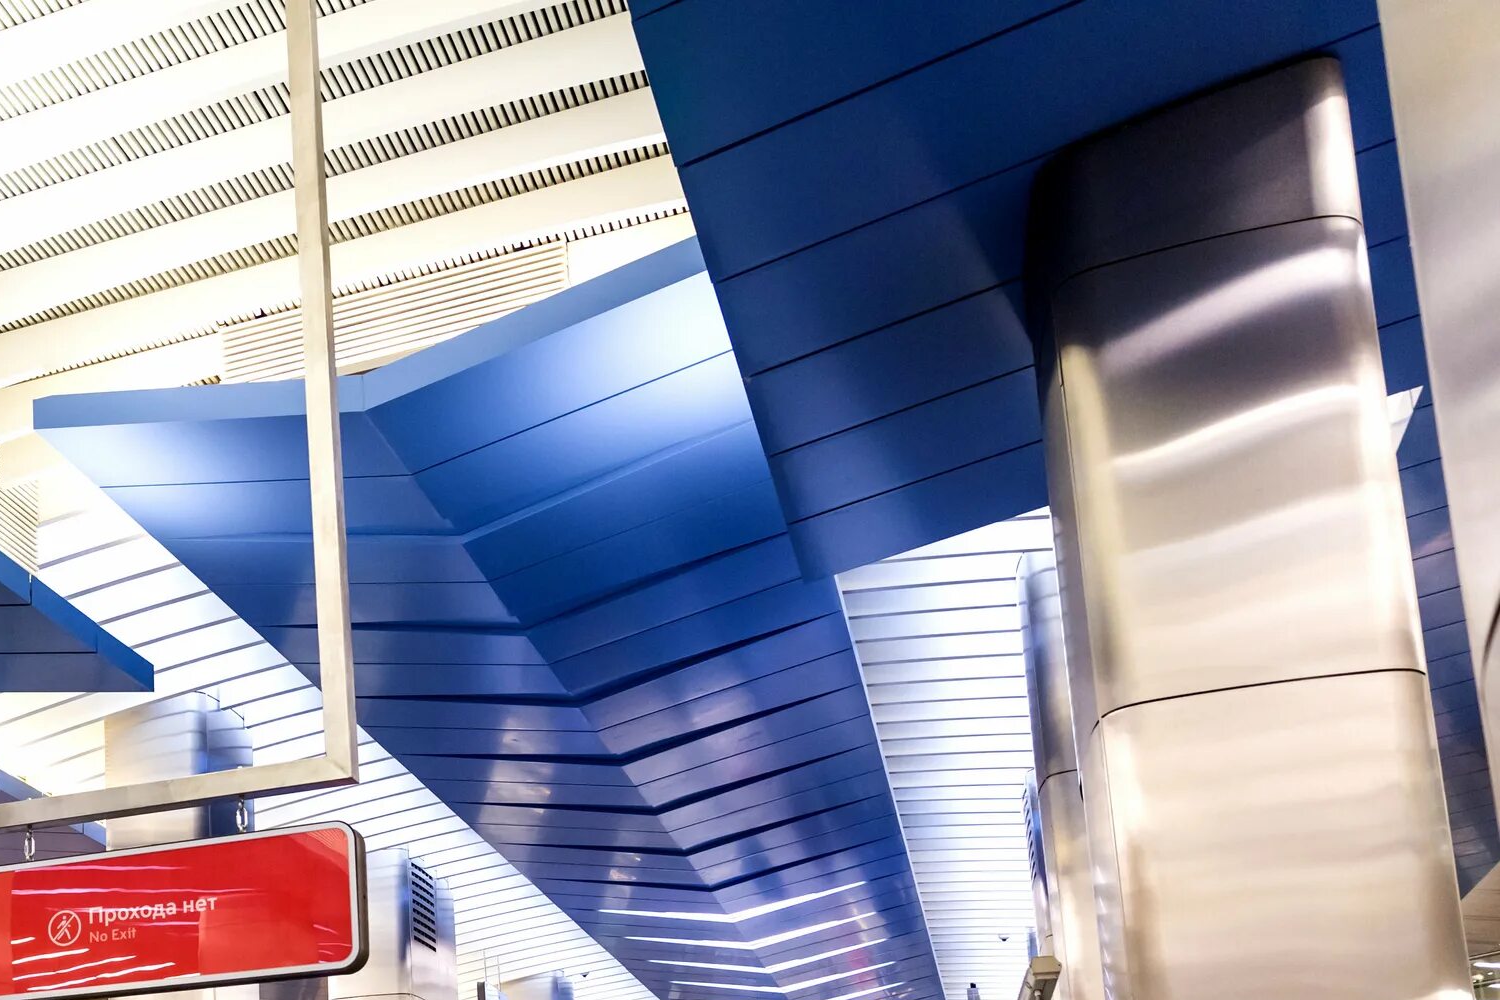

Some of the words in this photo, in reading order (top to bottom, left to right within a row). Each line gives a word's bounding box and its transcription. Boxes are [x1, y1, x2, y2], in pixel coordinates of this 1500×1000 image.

[88, 902, 177, 926] Прохода
[182, 897, 218, 914] нет
[89, 931, 108, 943] No
[111, 927, 137, 941] Exit
